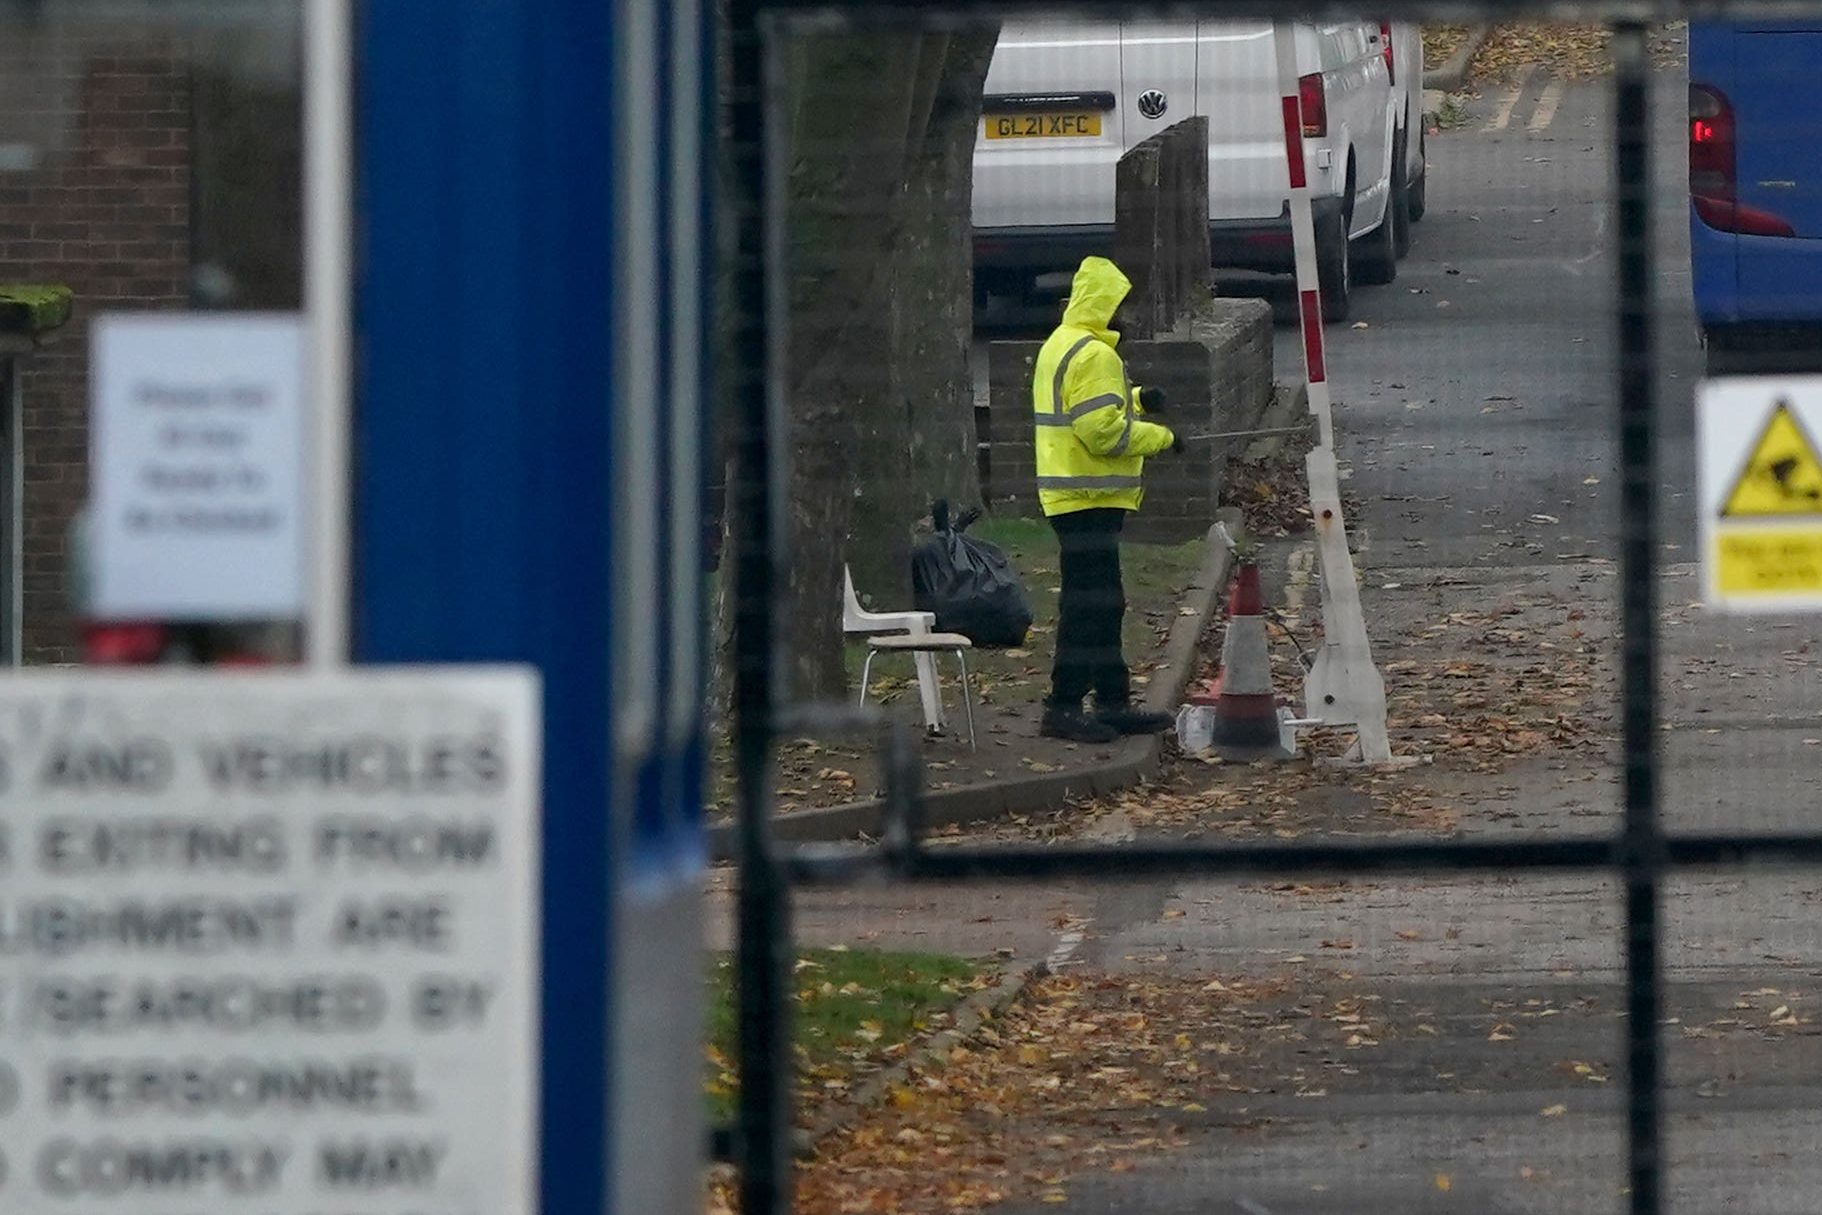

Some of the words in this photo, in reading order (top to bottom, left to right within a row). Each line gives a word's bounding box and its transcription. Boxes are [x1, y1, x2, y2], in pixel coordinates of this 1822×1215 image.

[998, 117, 1043, 136] GL21
[1049, 115, 1089, 134] XFC
[38, 735, 176, 798] AND
[200, 735, 511, 798] VEHICLES
[312, 811, 499, 876] FROM
[330, 891, 460, 954] ARE
[36, 973, 391, 1038] SEARCHED
[408, 969, 498, 1036] BY
[46, 1051, 432, 1120] PERSONNEL
[36, 1134, 292, 1200] COMPLY
[314, 1130, 450, 1194] MAY
